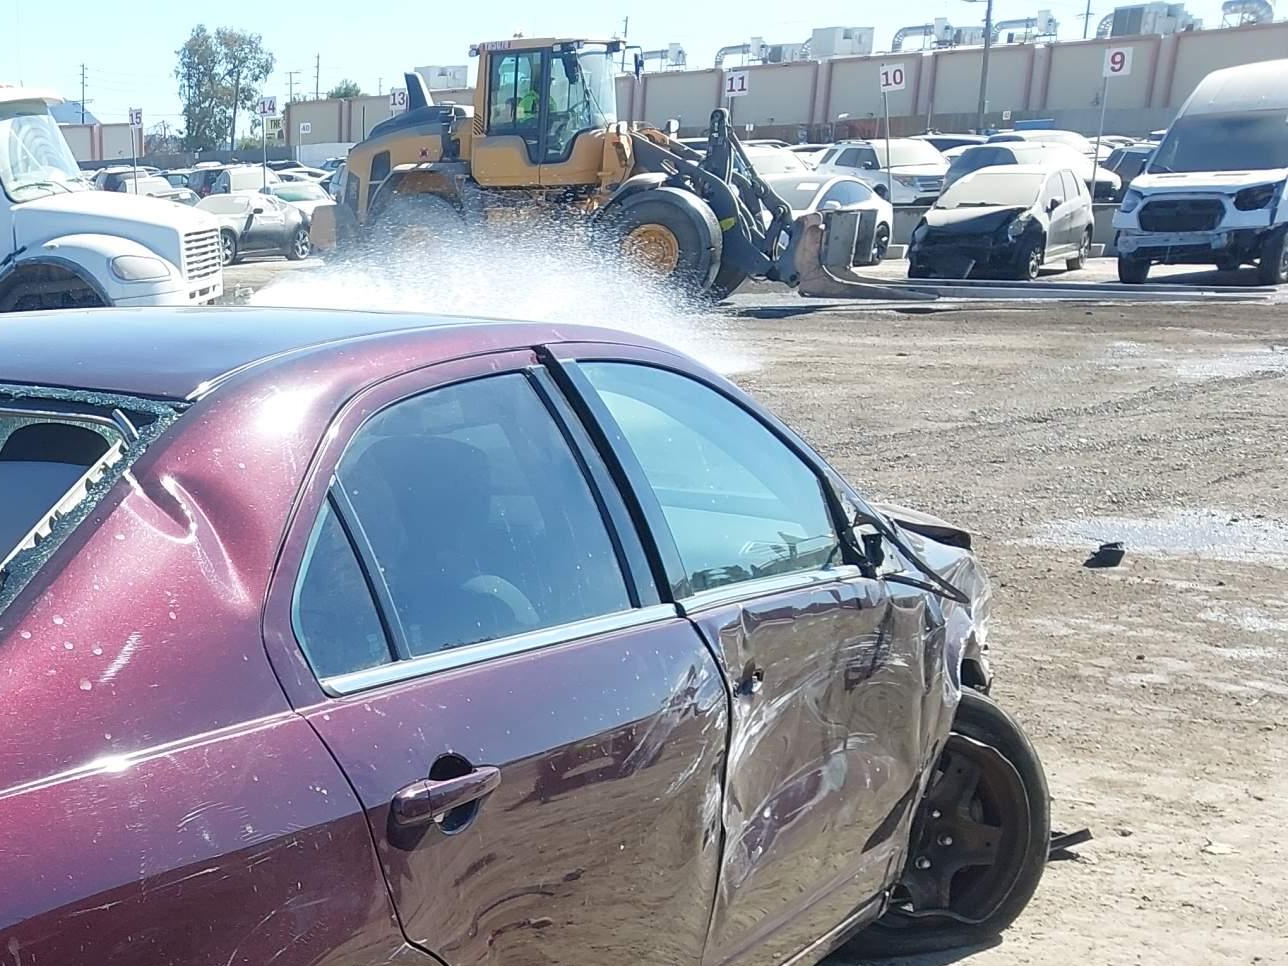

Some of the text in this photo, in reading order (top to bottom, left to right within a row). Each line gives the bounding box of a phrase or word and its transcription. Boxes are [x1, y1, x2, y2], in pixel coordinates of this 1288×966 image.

[1110, 51, 1125, 73] 9
[727, 75, 747, 92] 11
[881, 68, 903, 87] 10
[391, 92, 406, 106] 13
[260, 101, 276, 114] 14
[129, 111, 142, 125] 15
